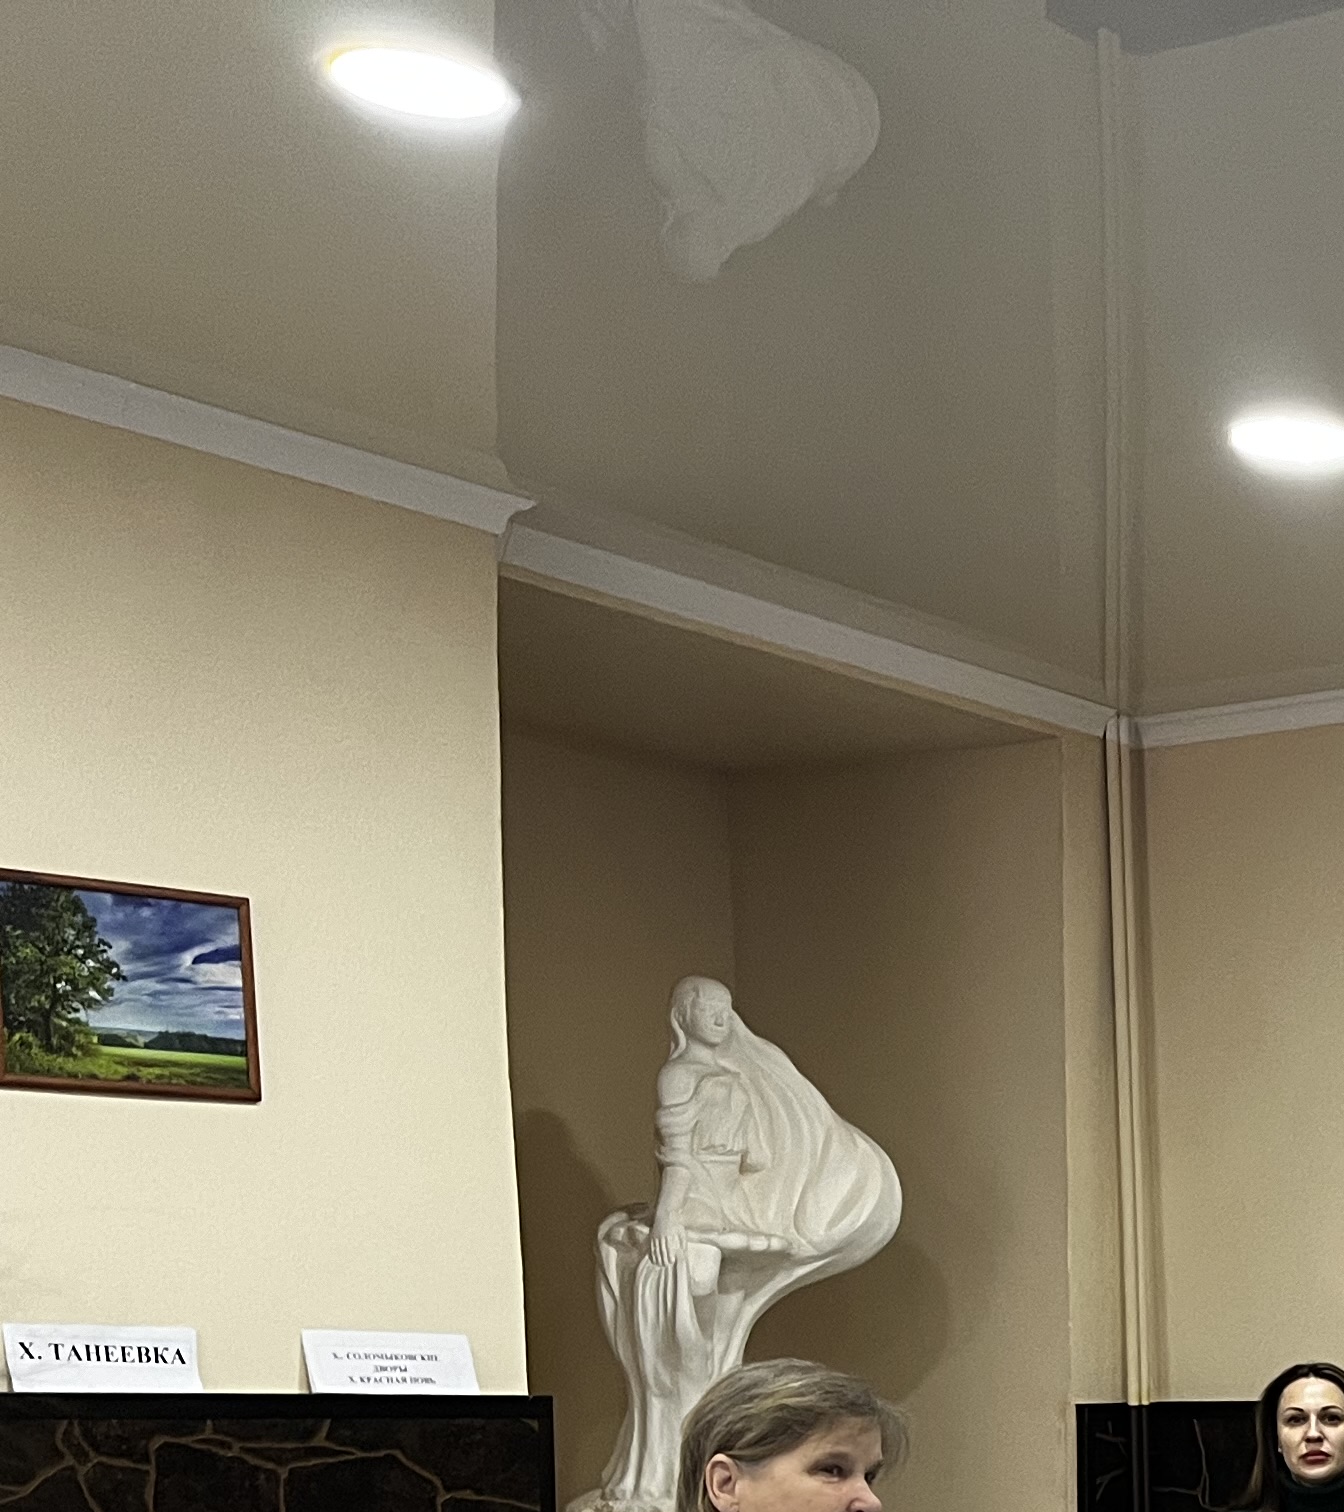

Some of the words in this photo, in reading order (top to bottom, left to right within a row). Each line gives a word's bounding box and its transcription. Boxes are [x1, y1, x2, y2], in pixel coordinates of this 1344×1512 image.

[18, 1341, 43, 1360] Х.
[48, 1342, 187, 1365] ТАНЕЕВКА
[359, 1375, 408, 1384] КРАСНАЯ
